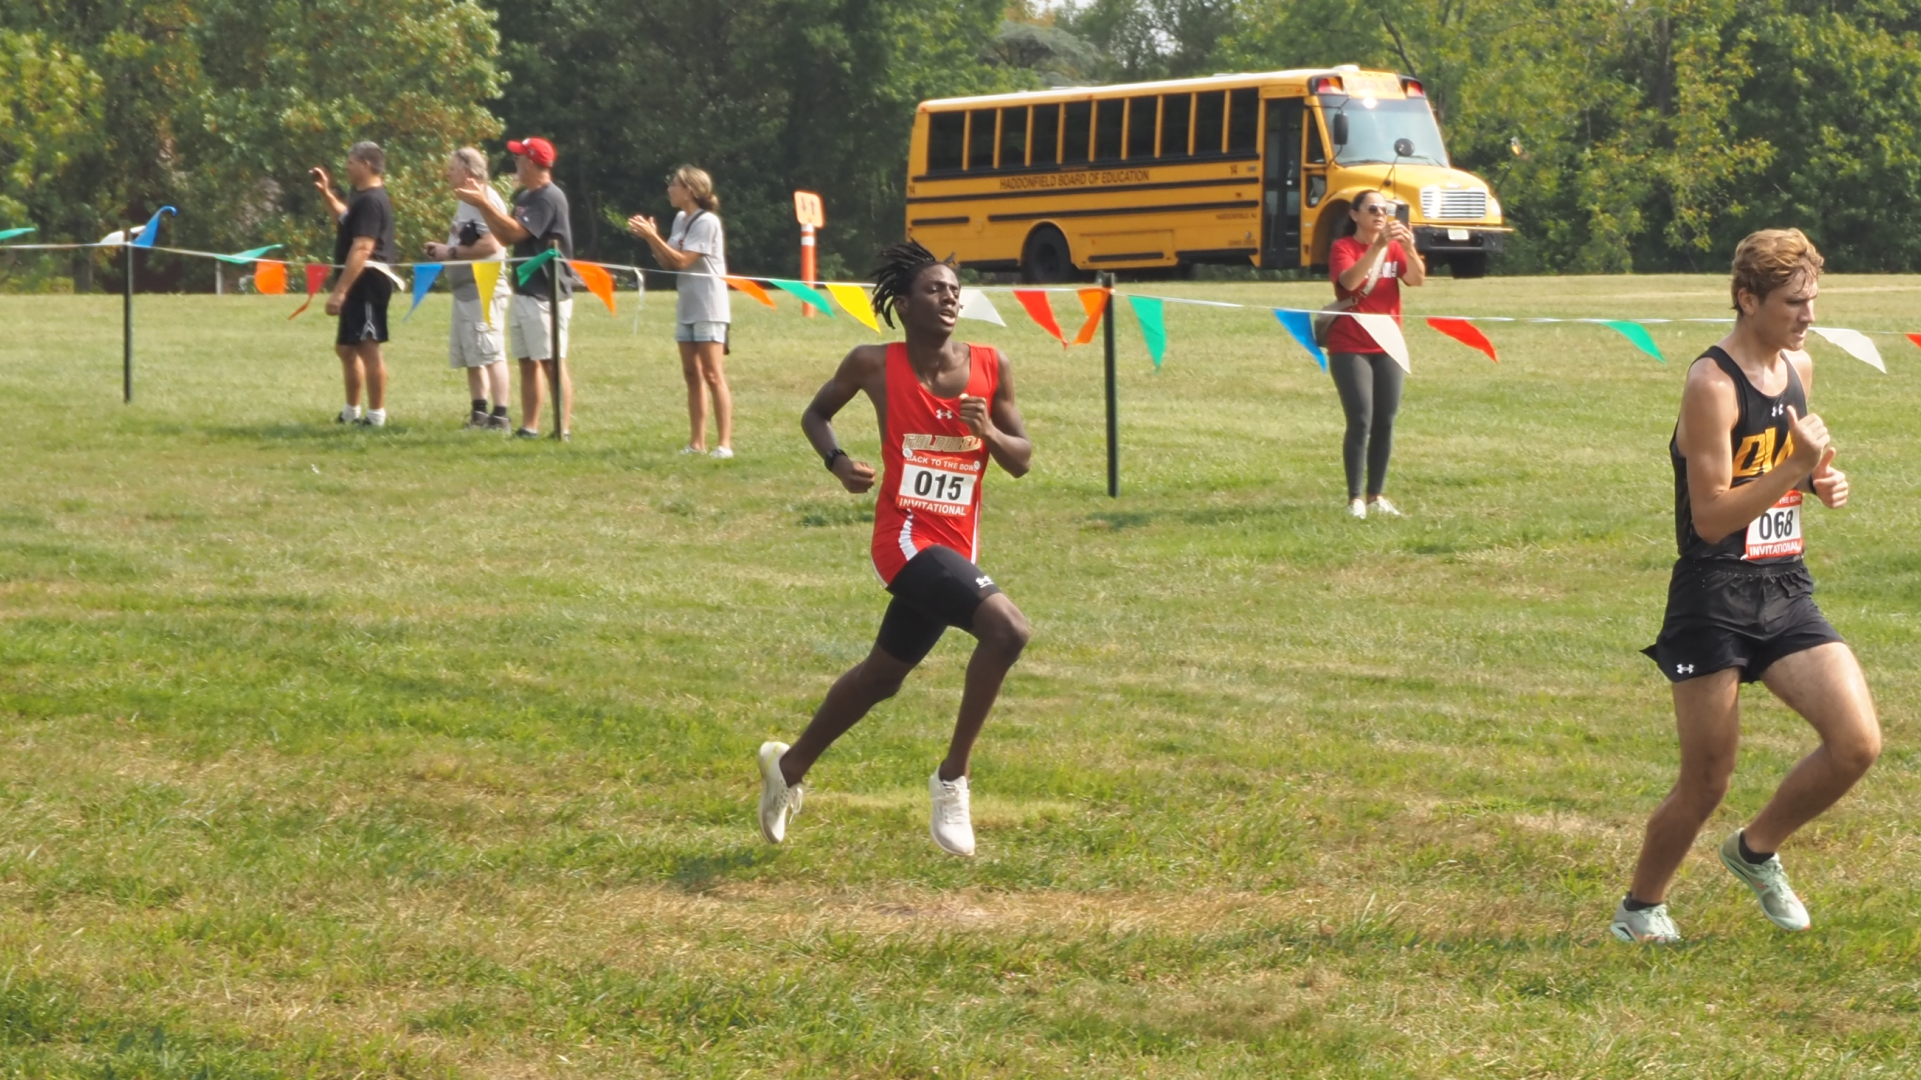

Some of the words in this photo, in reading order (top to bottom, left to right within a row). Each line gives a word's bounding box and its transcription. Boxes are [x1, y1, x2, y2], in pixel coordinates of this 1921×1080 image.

[999, 174, 1057, 190] HADDONFIELD
[1058, 172, 1087, 187] BOARD
[1088, 172, 1100, 185] OF
[1101, 169, 1150, 184] EDUCATION
[931, 458, 942, 467] TO
[943, 461, 958, 470] THE
[914, 470, 965, 501] 015
[899, 498, 967, 516] INVITATIONAL
[1758, 509, 1794, 541] 068
[1749, 541, 1802, 556] INVITATIONAL
